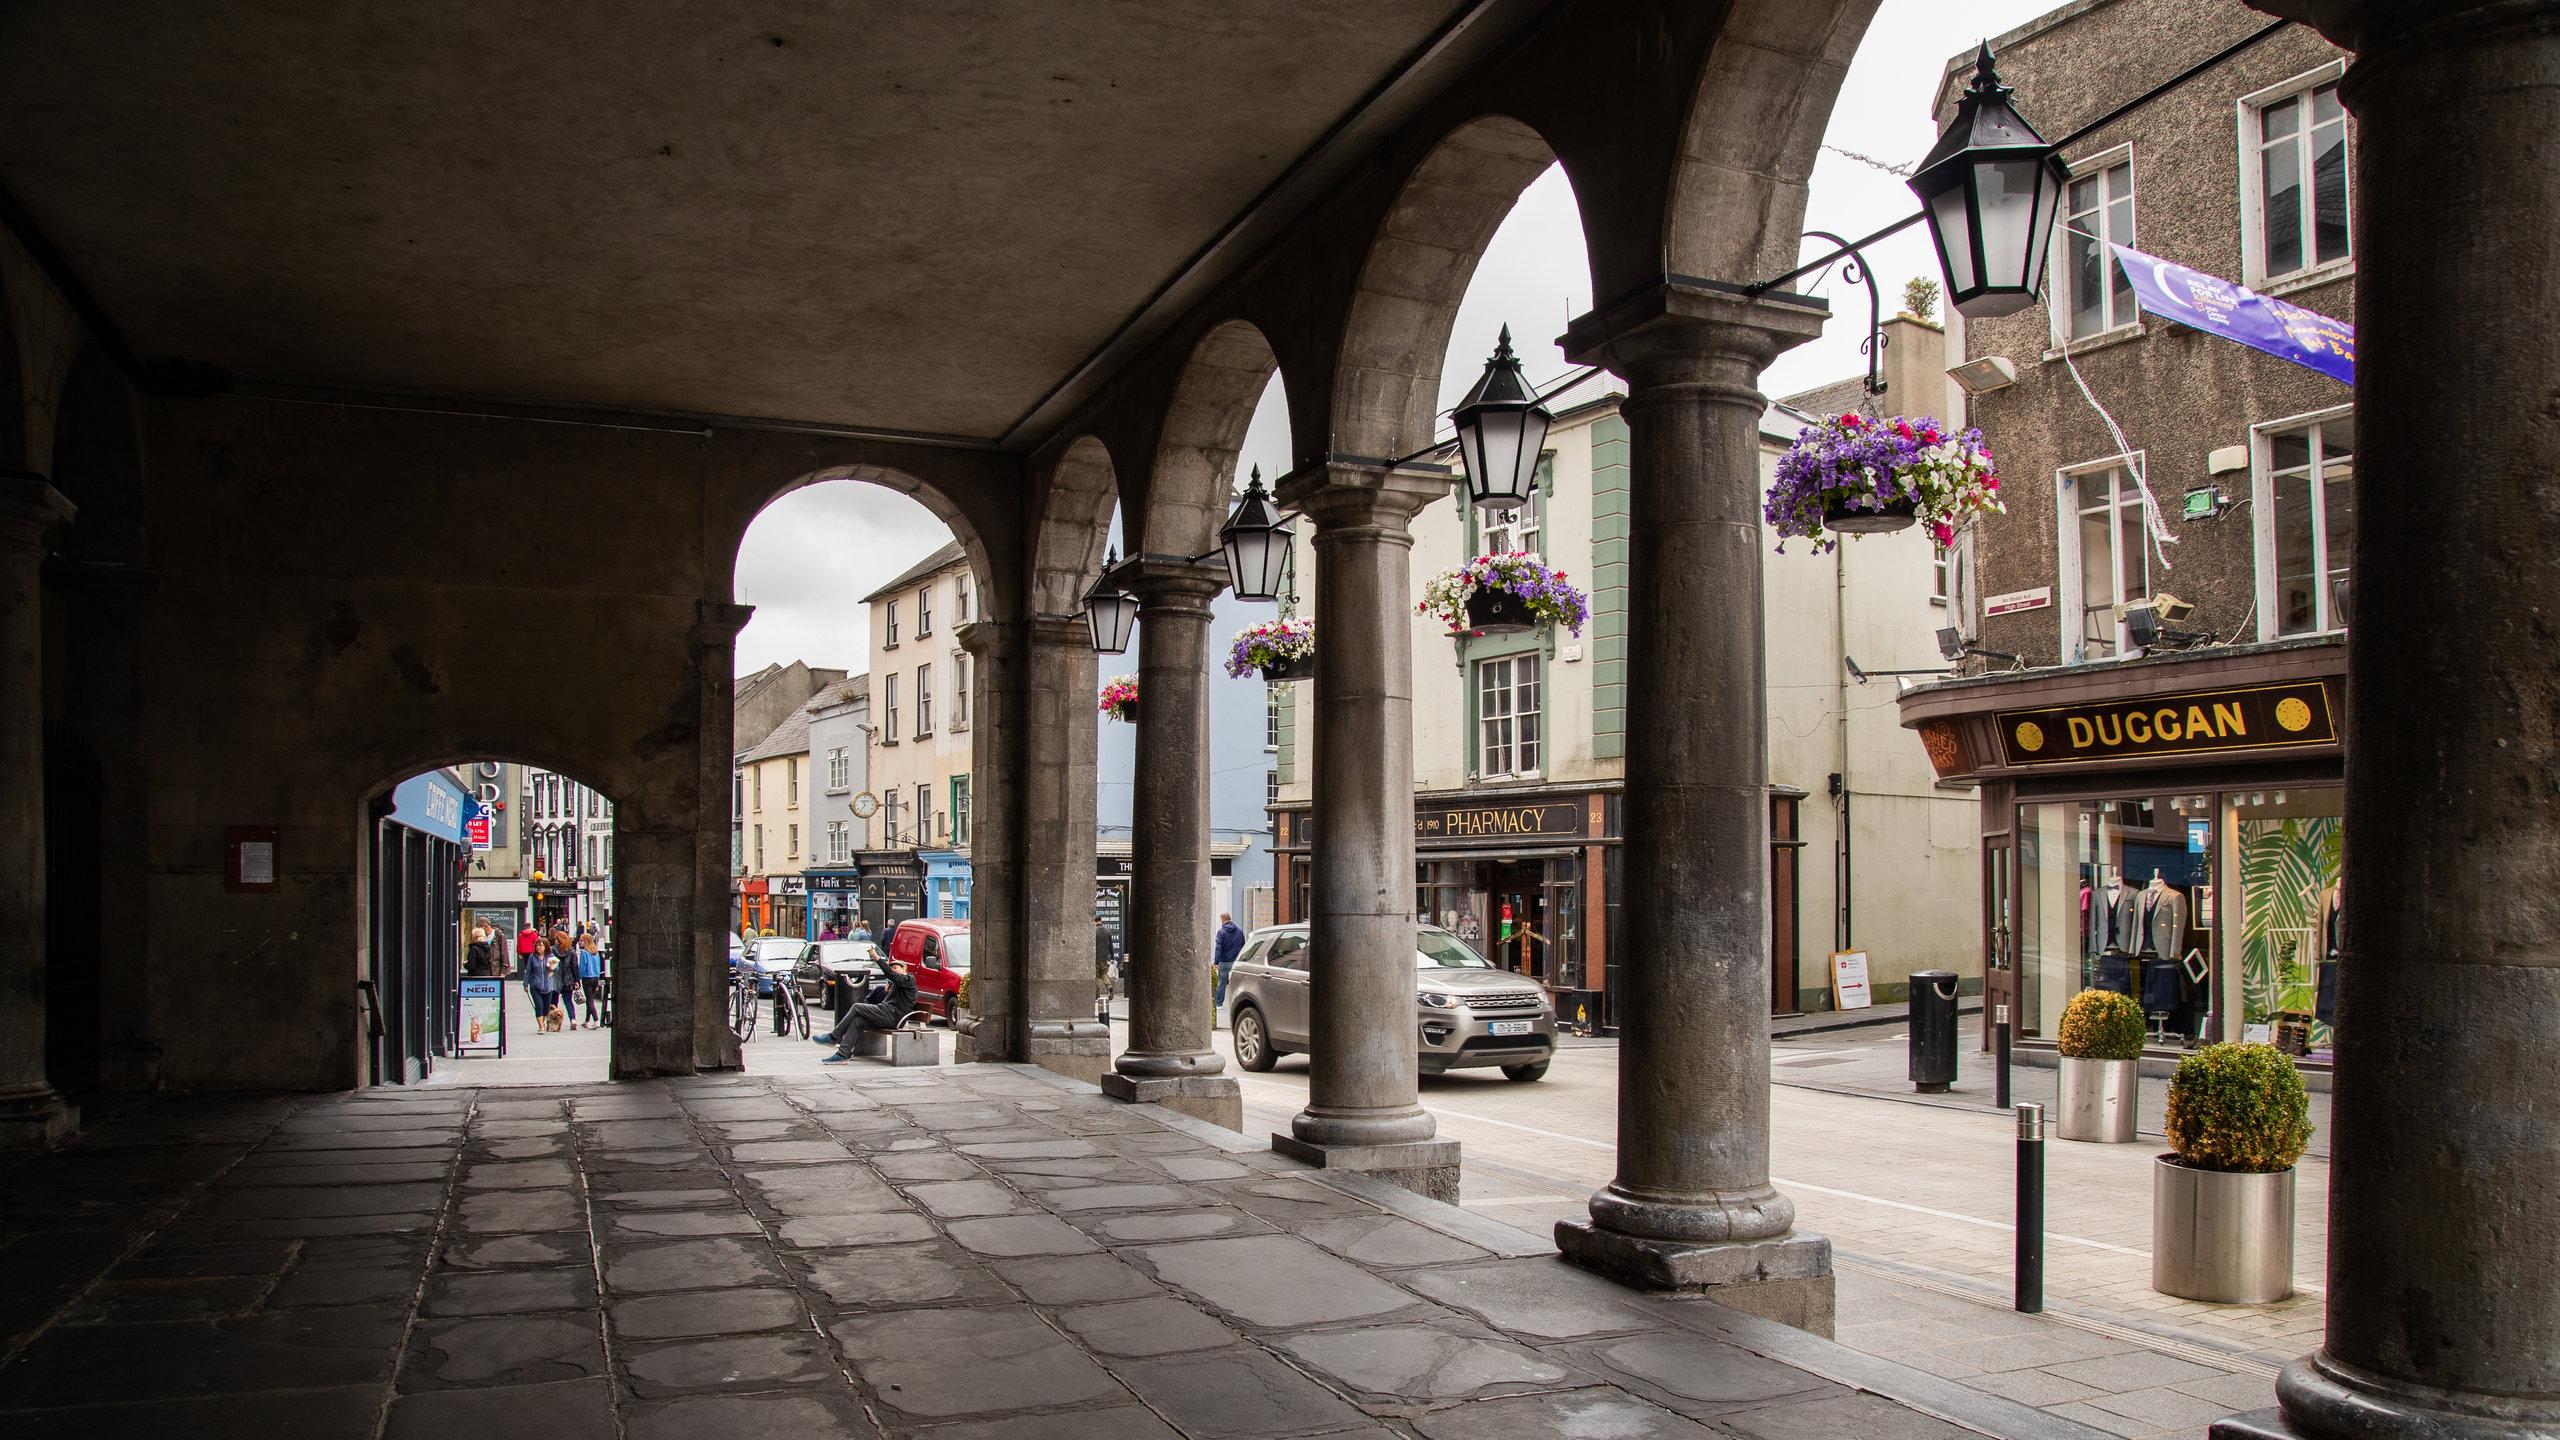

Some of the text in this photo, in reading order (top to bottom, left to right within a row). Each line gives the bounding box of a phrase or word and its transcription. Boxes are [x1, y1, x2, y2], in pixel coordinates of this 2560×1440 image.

[2067, 701, 2247, 749] DUGGAN
[1446, 808, 1546, 835] PHARMACY
[1590, 812, 1602, 823] 23
[1280, 826, 1289, 836] 22
[466, 986, 496, 994] NERO
